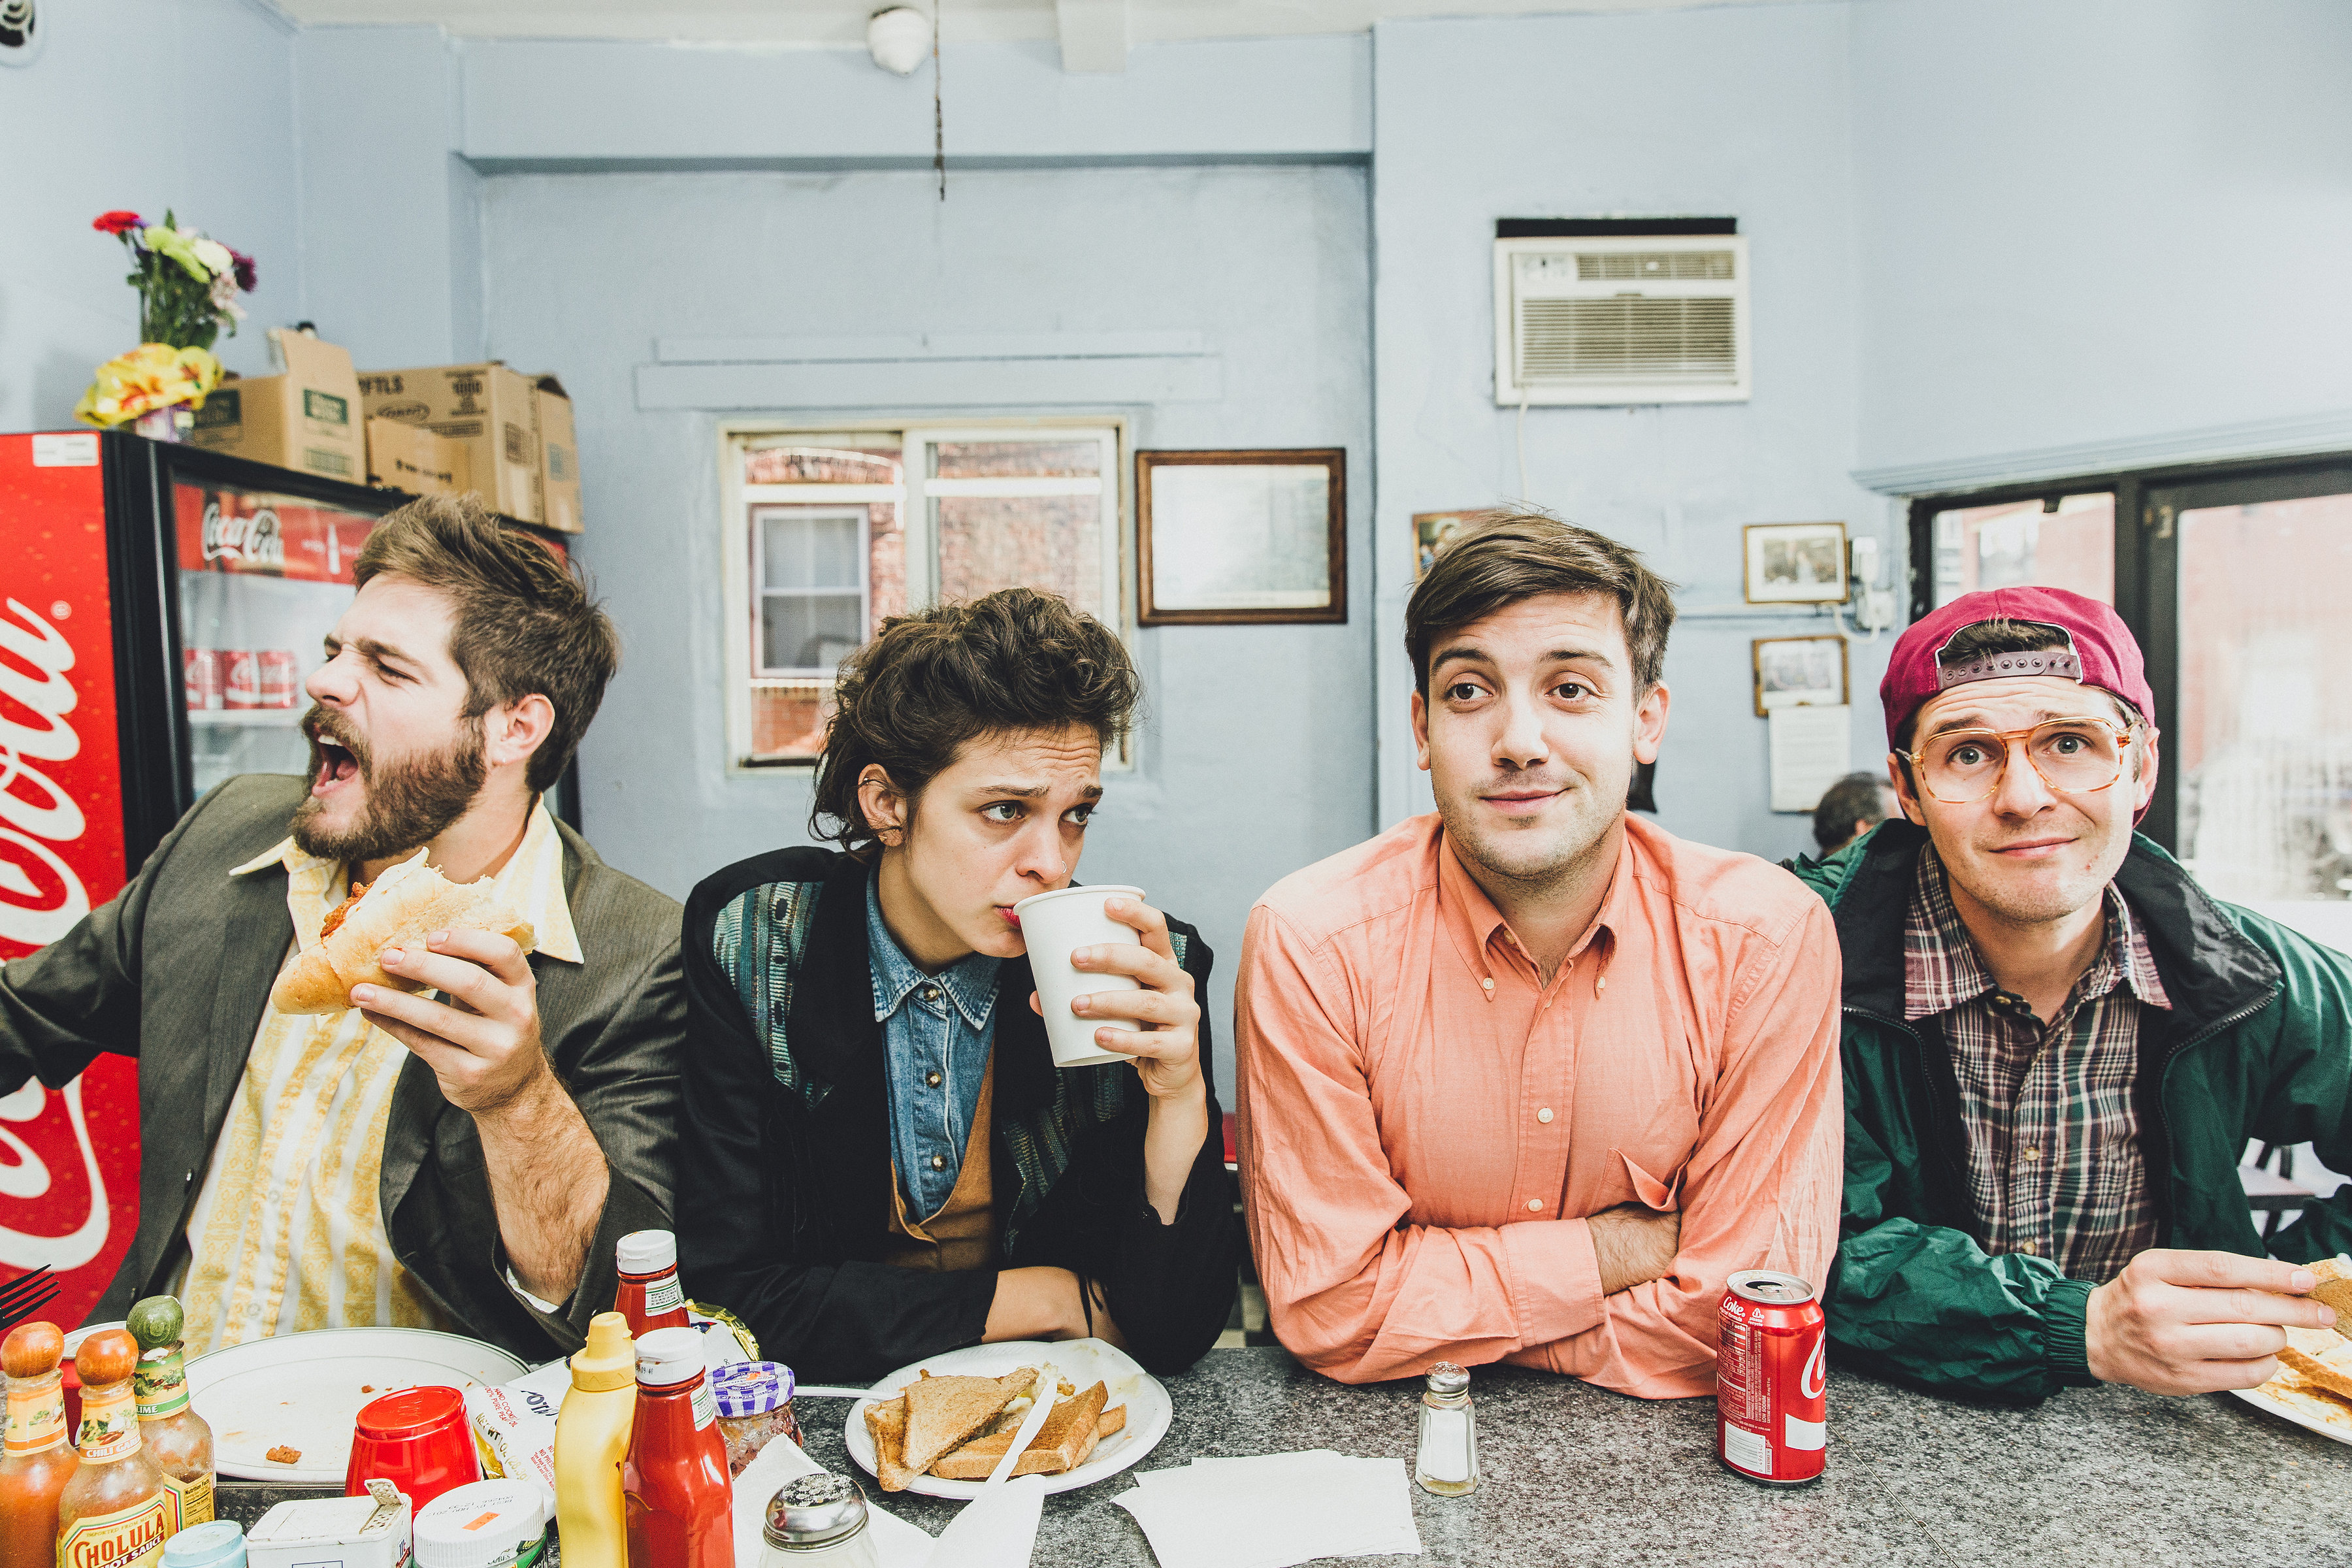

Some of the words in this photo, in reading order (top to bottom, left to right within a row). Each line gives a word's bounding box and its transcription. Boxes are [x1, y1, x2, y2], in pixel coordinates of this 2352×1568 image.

[1723, 1296, 1744, 1316] Coke
[494, 1388, 505, 1401] HAND
[137, 1405, 158, 1414] LIME
[491, 1397, 502, 1411] PURE
[487, 1426, 500, 1441] WT
[86, 1447, 114, 1458] CHILI
[87, 1527, 120, 1537] IMPORTED
[122, 1520, 139, 1531] FROM
[140, 1510, 158, 1523] MEXICO
[74, 1512, 165, 1568] CHOLULA
[131, 1535, 163, 1560] SAUCE
